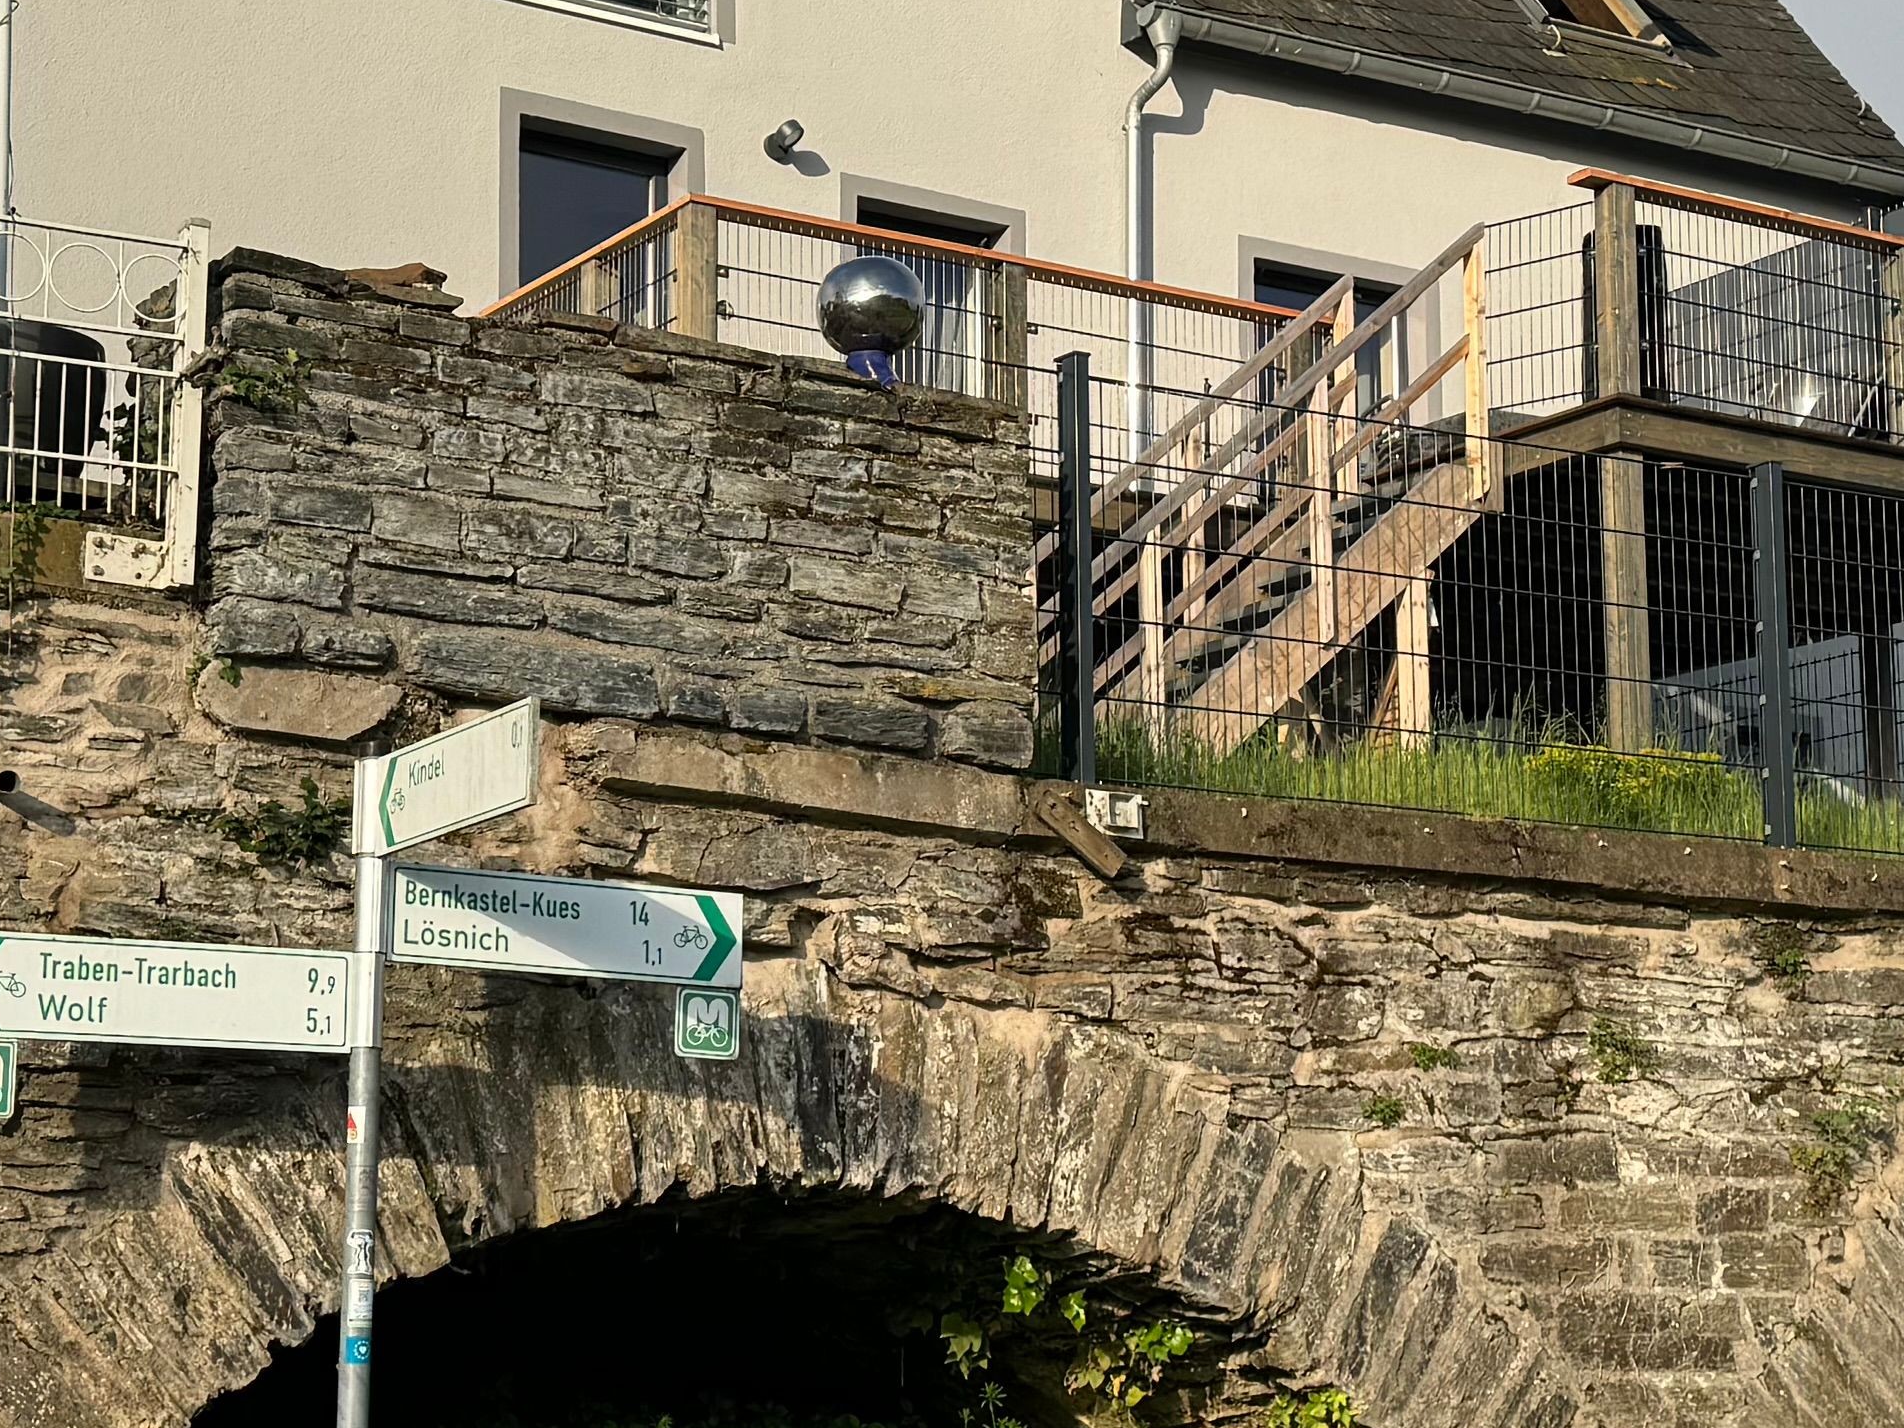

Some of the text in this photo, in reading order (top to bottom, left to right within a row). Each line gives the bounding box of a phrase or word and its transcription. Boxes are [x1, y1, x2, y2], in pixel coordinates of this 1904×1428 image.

[408, 749, 445, 788] Kindel
[405, 880, 650, 926] Bernkastel-Kues 14
[403, 919, 662, 966] Lösnich 1,1
[40, 952, 336, 995] Traben-Trarbach 9,9
[38, 993, 331, 1035] Wolf 5,1
